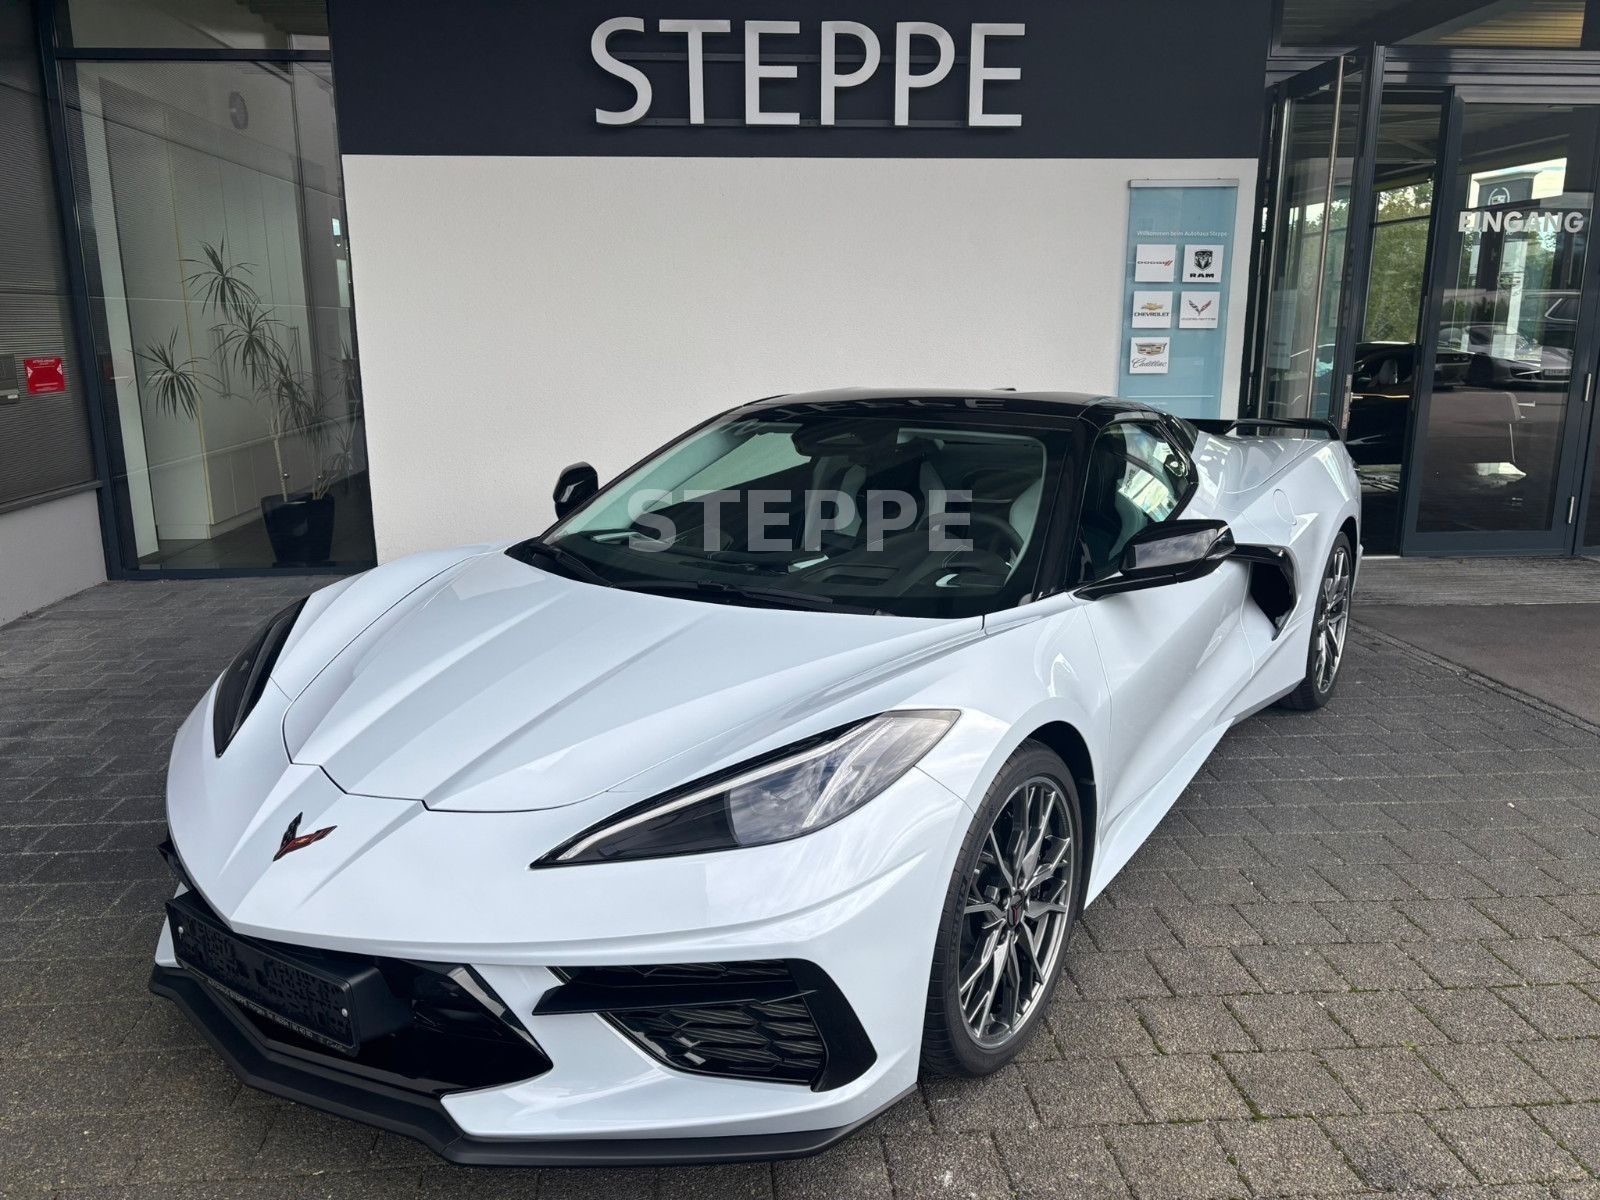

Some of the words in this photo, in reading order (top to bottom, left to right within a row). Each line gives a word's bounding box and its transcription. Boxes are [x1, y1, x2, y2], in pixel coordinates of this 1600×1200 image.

[591, 17, 1026, 127] STEPPE
[1458, 211, 1584, 233] EINGANG
[1131, 357, 1168, 369] Cadillac
